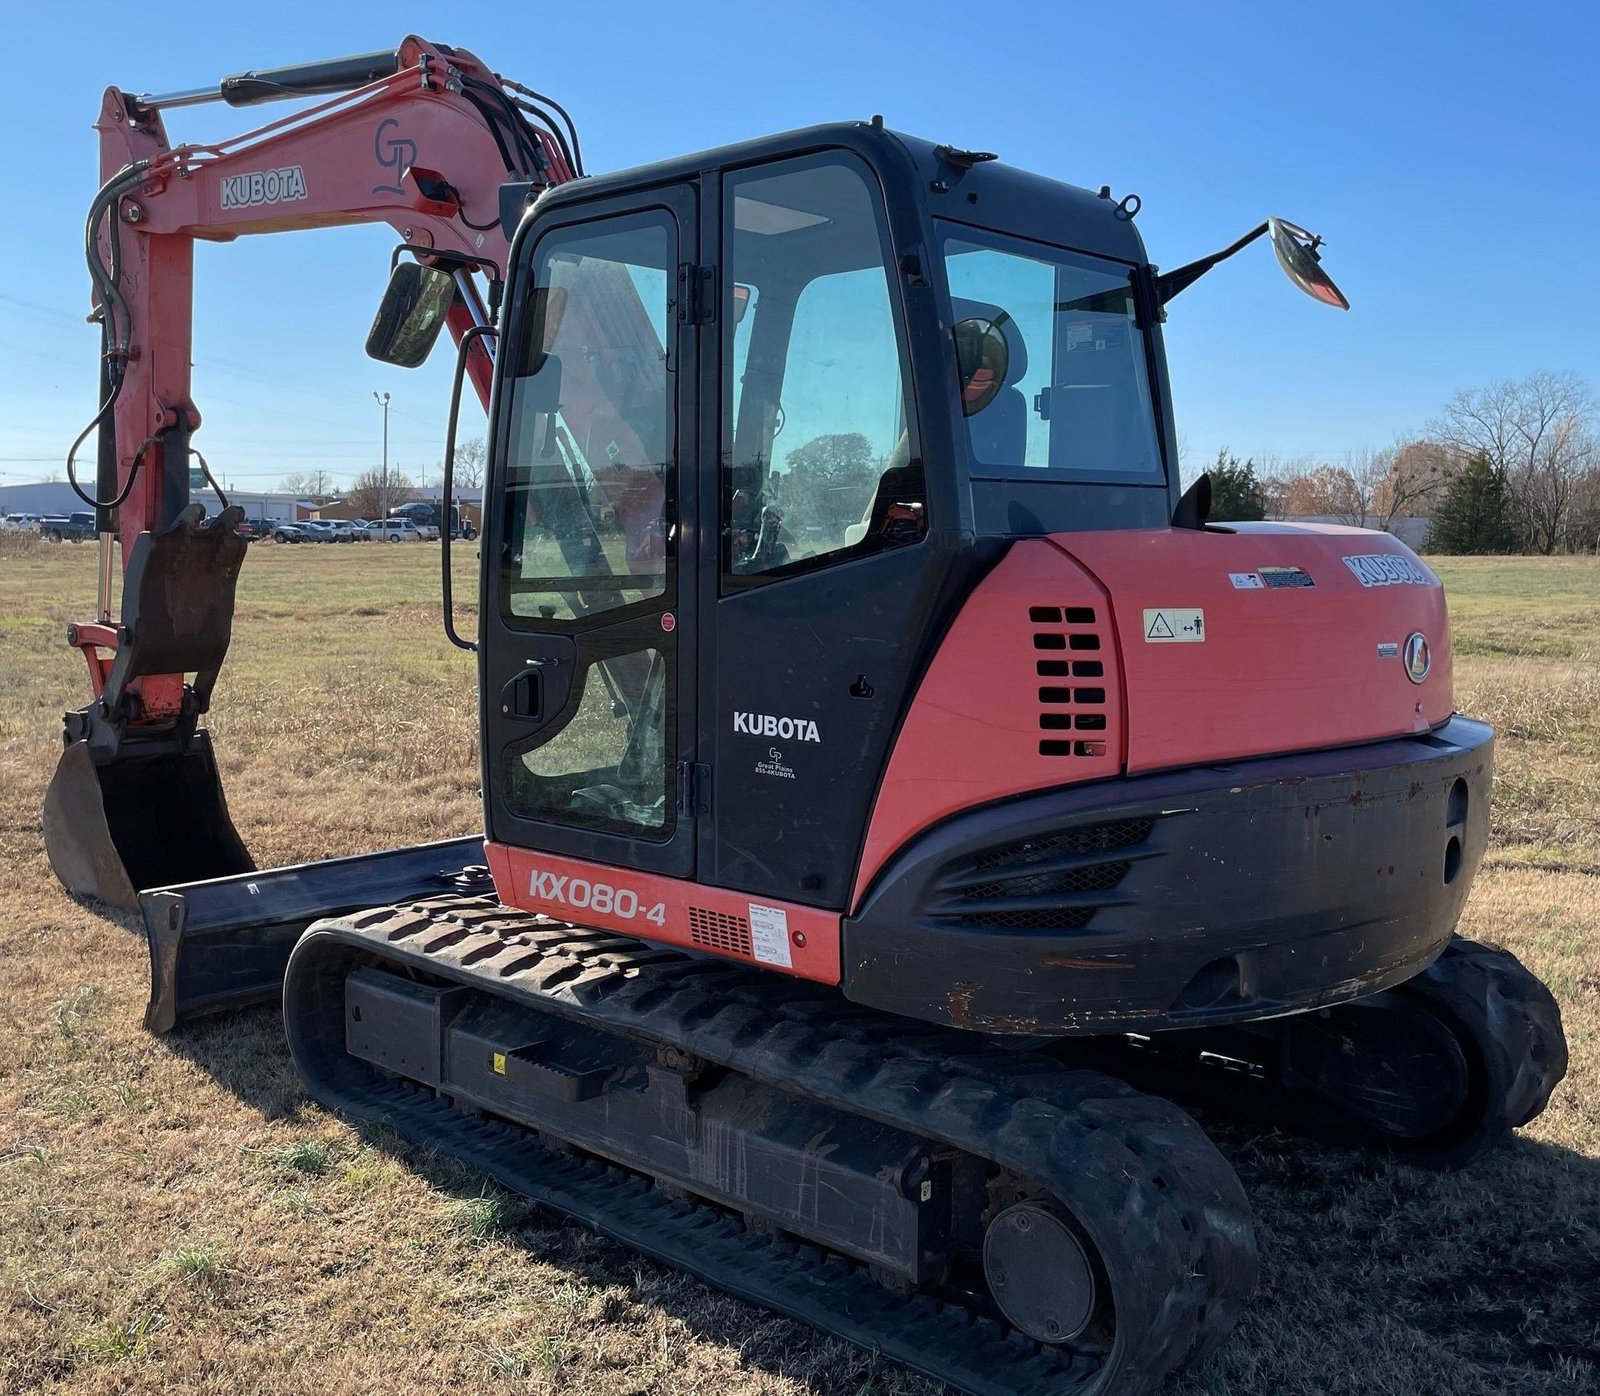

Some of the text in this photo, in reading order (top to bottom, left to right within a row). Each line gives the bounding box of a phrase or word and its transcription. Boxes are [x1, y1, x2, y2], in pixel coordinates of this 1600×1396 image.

[221, 166, 306, 207] KUBOTA
[733, 711, 821, 743] KUBOTA
[755, 767, 796, 779] 855-4KUBOTA
[757, 761, 793, 773] Great Plains
[529, 869, 666, 927] KX080-4
